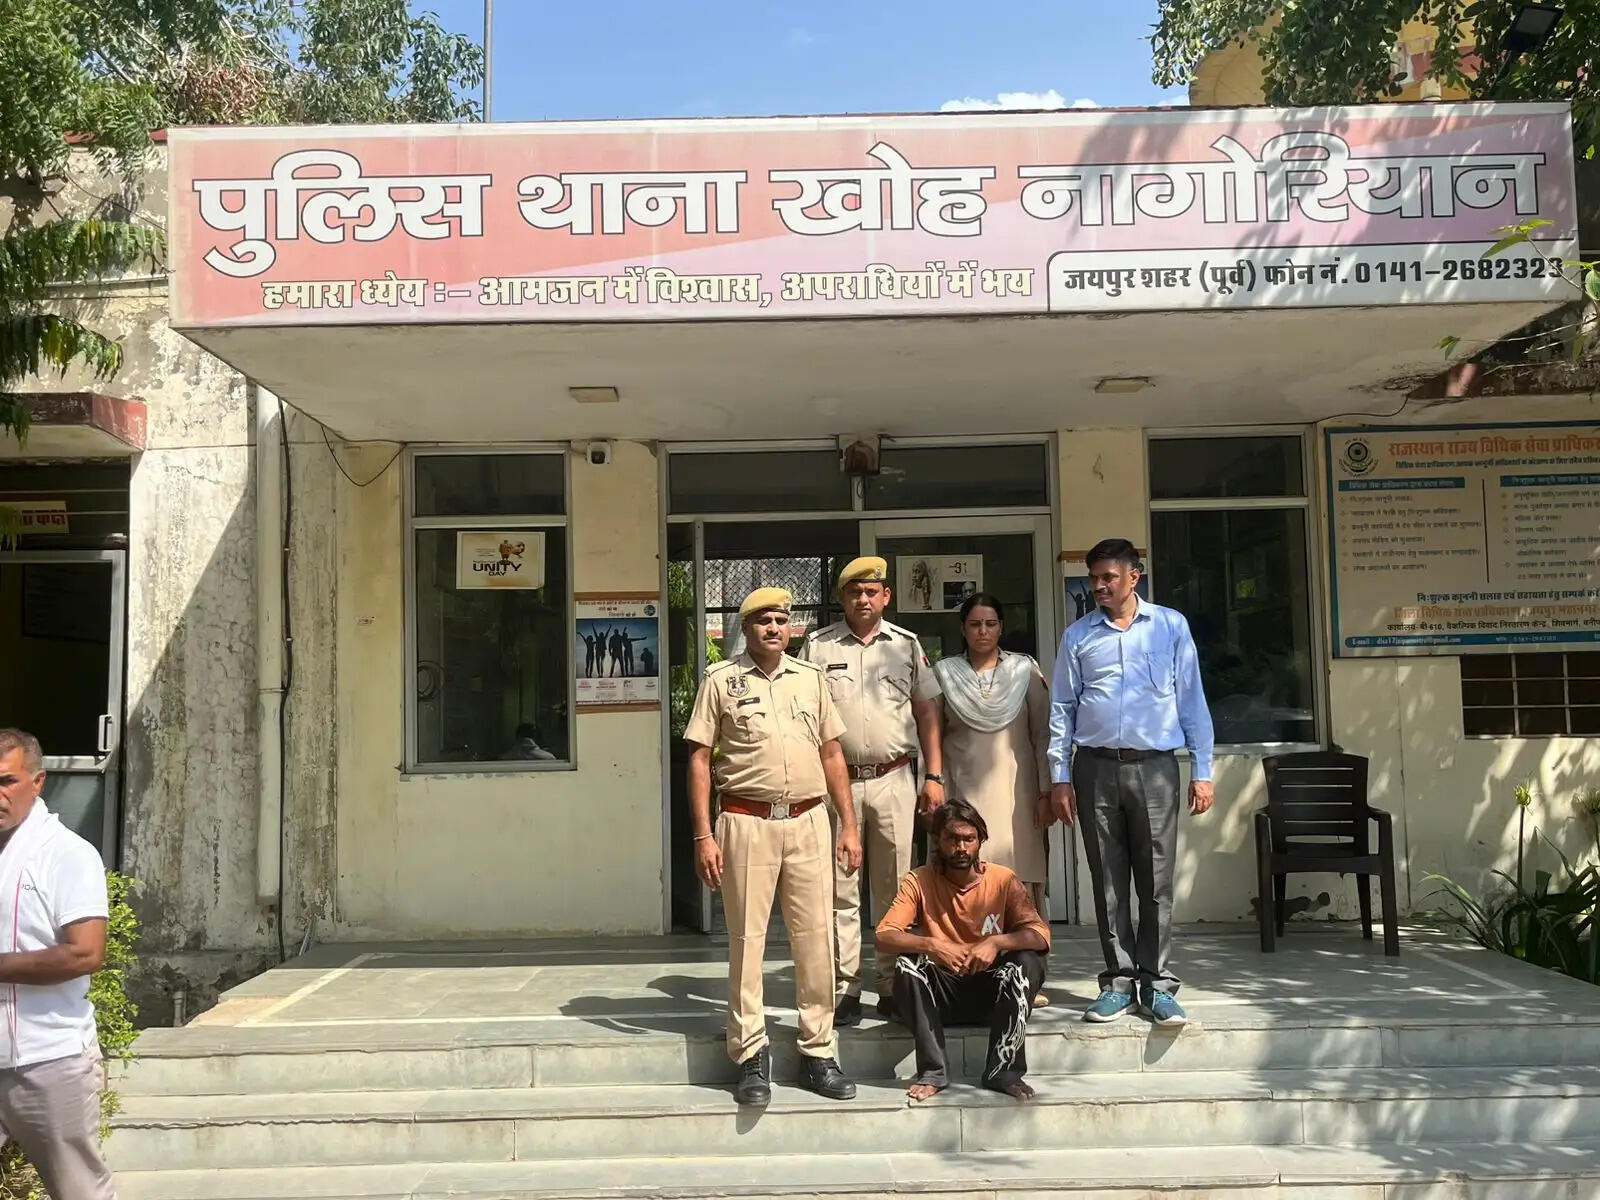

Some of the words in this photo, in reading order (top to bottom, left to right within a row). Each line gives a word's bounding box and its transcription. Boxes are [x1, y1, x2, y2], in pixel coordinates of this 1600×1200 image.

[192, 148, 493, 278] पुलिस
[517, 170, 748, 235] थाना
[768, 141, 996, 237] खोह
[1018, 131, 1546, 227] नागोरियान
[261, 280, 356, 309] हमारा
[360, 270, 428, 307] ध्येय
[478, 276, 608, 305] आमजन
[612, 266, 644, 304] में
[646, 267, 772, 307] विश्वास,
[781, 261, 945, 301] अपराधियों
[947, 260, 979, 298] में
[981, 268, 1034, 297] भय
[1063, 269, 1136, 297] जयपुर
[1140, 267, 1192, 289] शहर
[1199, 259, 1257, 295] (पूर्व)
[1263, 258, 1315, 286] फोन
[1319, 256, 1348, 284] नं.
[1355, 256, 1563, 284] 0141-2682323
[1388, 442, 1444, 456] राजस्थान
[473, 561, 522, 572] UNITY
